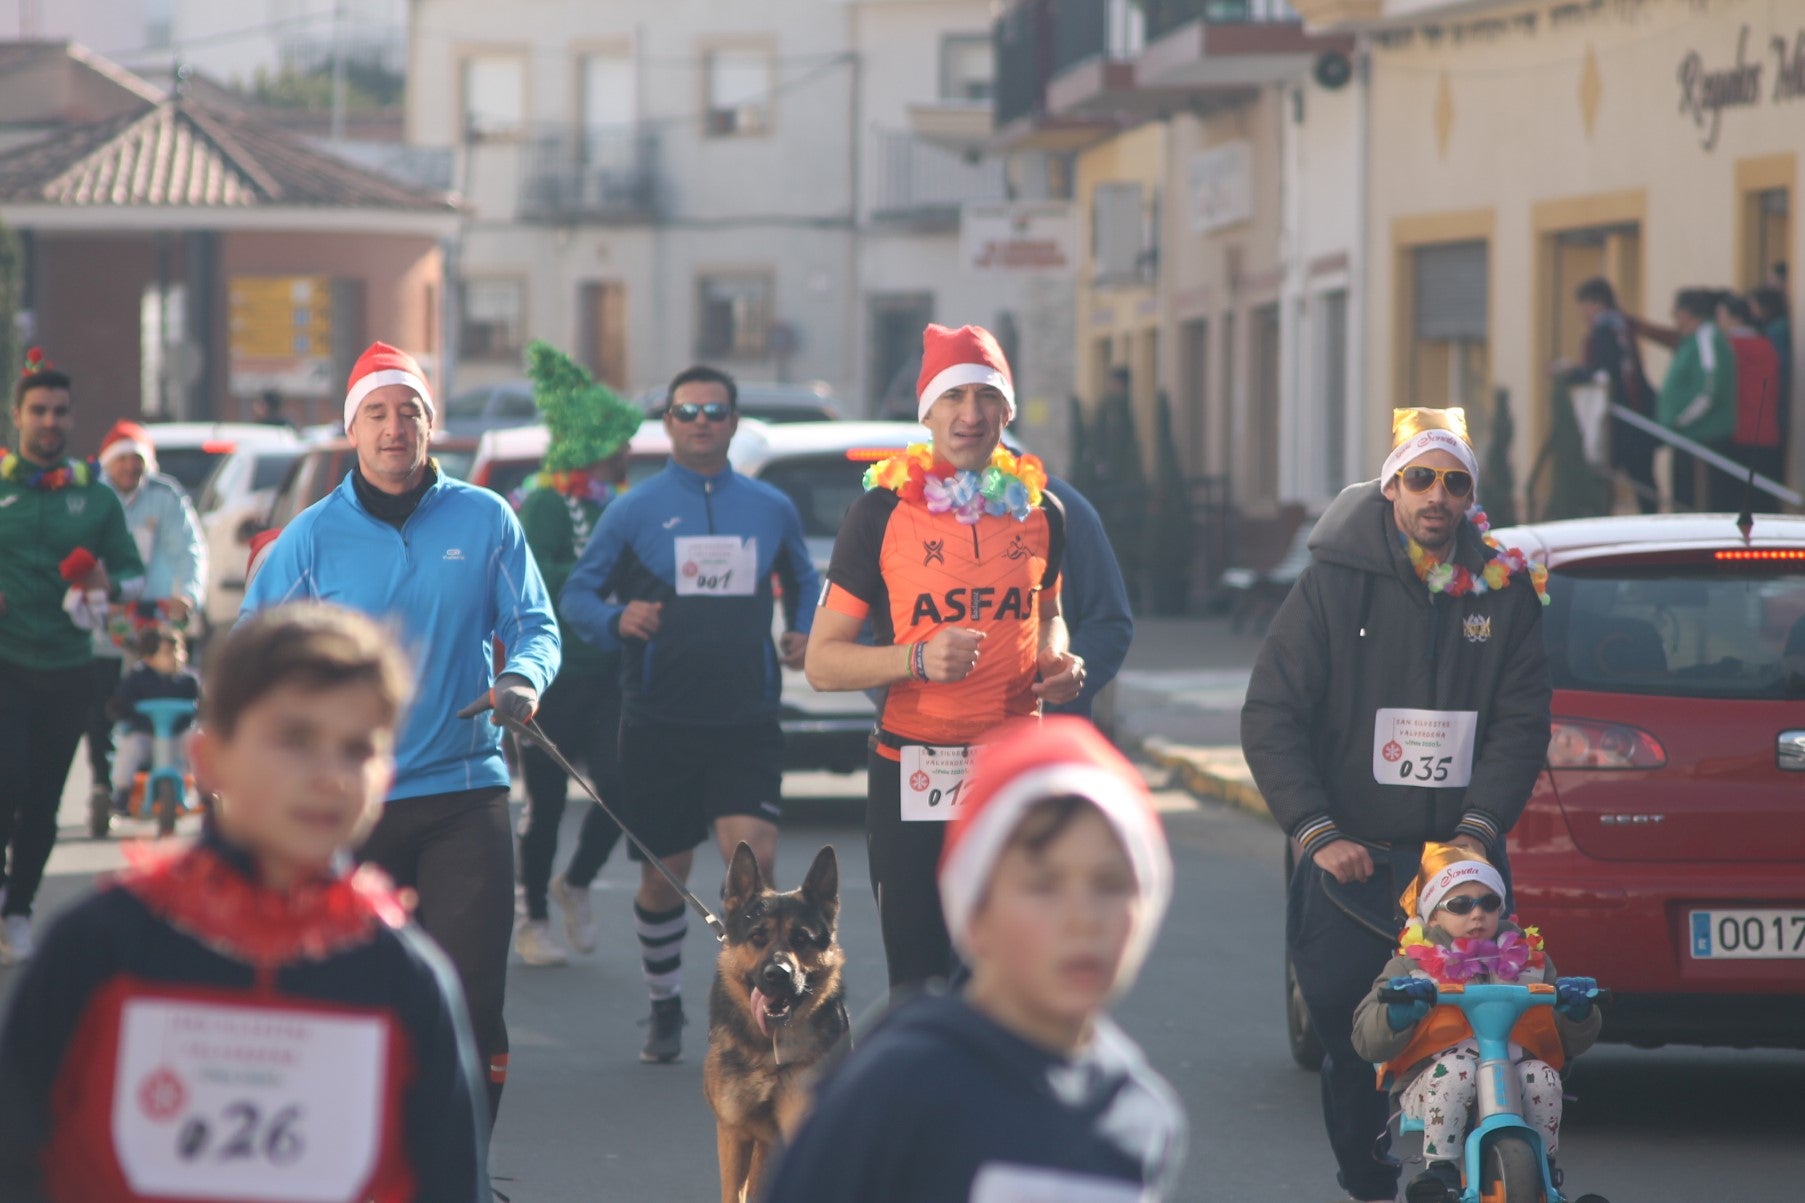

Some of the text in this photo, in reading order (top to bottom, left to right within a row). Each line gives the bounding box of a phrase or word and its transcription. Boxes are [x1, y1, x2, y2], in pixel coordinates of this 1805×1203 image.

[696, 569, 733, 589] 001
[1414, 719, 1450, 728] SILVESTRE
[1400, 756, 1452, 782] 035
[1718, 916, 1805, 951] 0017
[175, 1099, 304, 1166] 026
